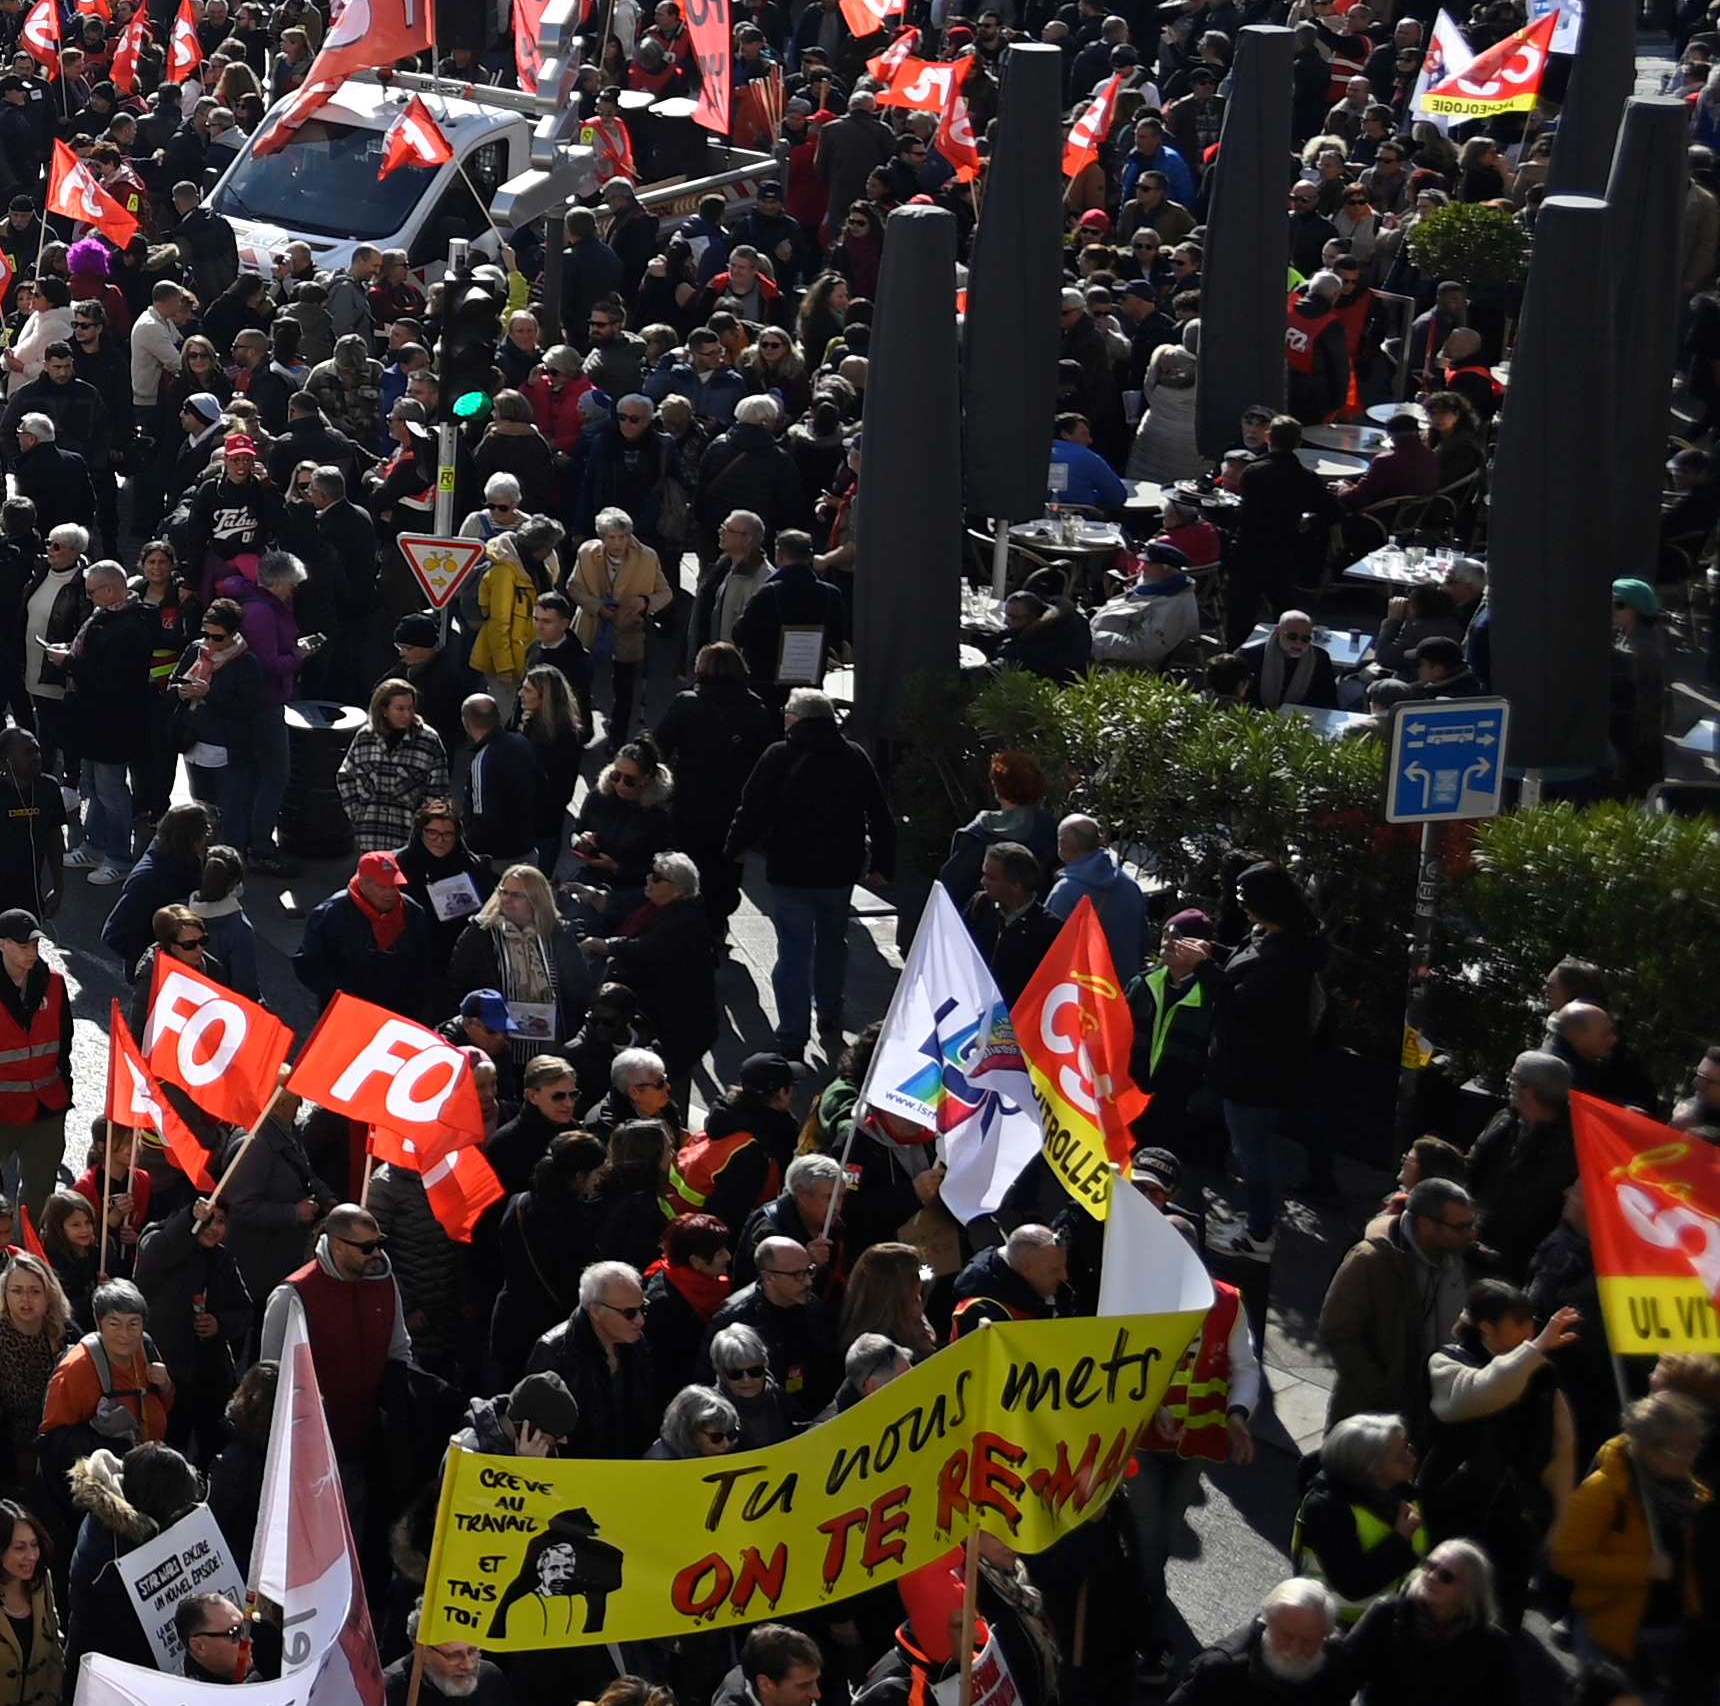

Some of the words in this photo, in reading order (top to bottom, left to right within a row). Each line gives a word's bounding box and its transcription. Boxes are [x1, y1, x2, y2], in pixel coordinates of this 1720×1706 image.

[148, 972, 248, 1088] FO
[330, 1018, 467, 1125] FO
[1628, 1295, 1671, 1339] UL
[702, 1465, 799, 1532] Tu
[825, 1369, 973, 1495] nous
[1001, 1327, 1162, 1413] mets
[494, 1495, 526, 1514] AU
[181, 1540, 211, 1569] ENCORE
[477, 1554, 508, 1574] ET
[670, 1540, 789, 1624] ON
[817, 1483, 912, 1596] TE
[165, 1578, 193, 1608] NOUVEL
